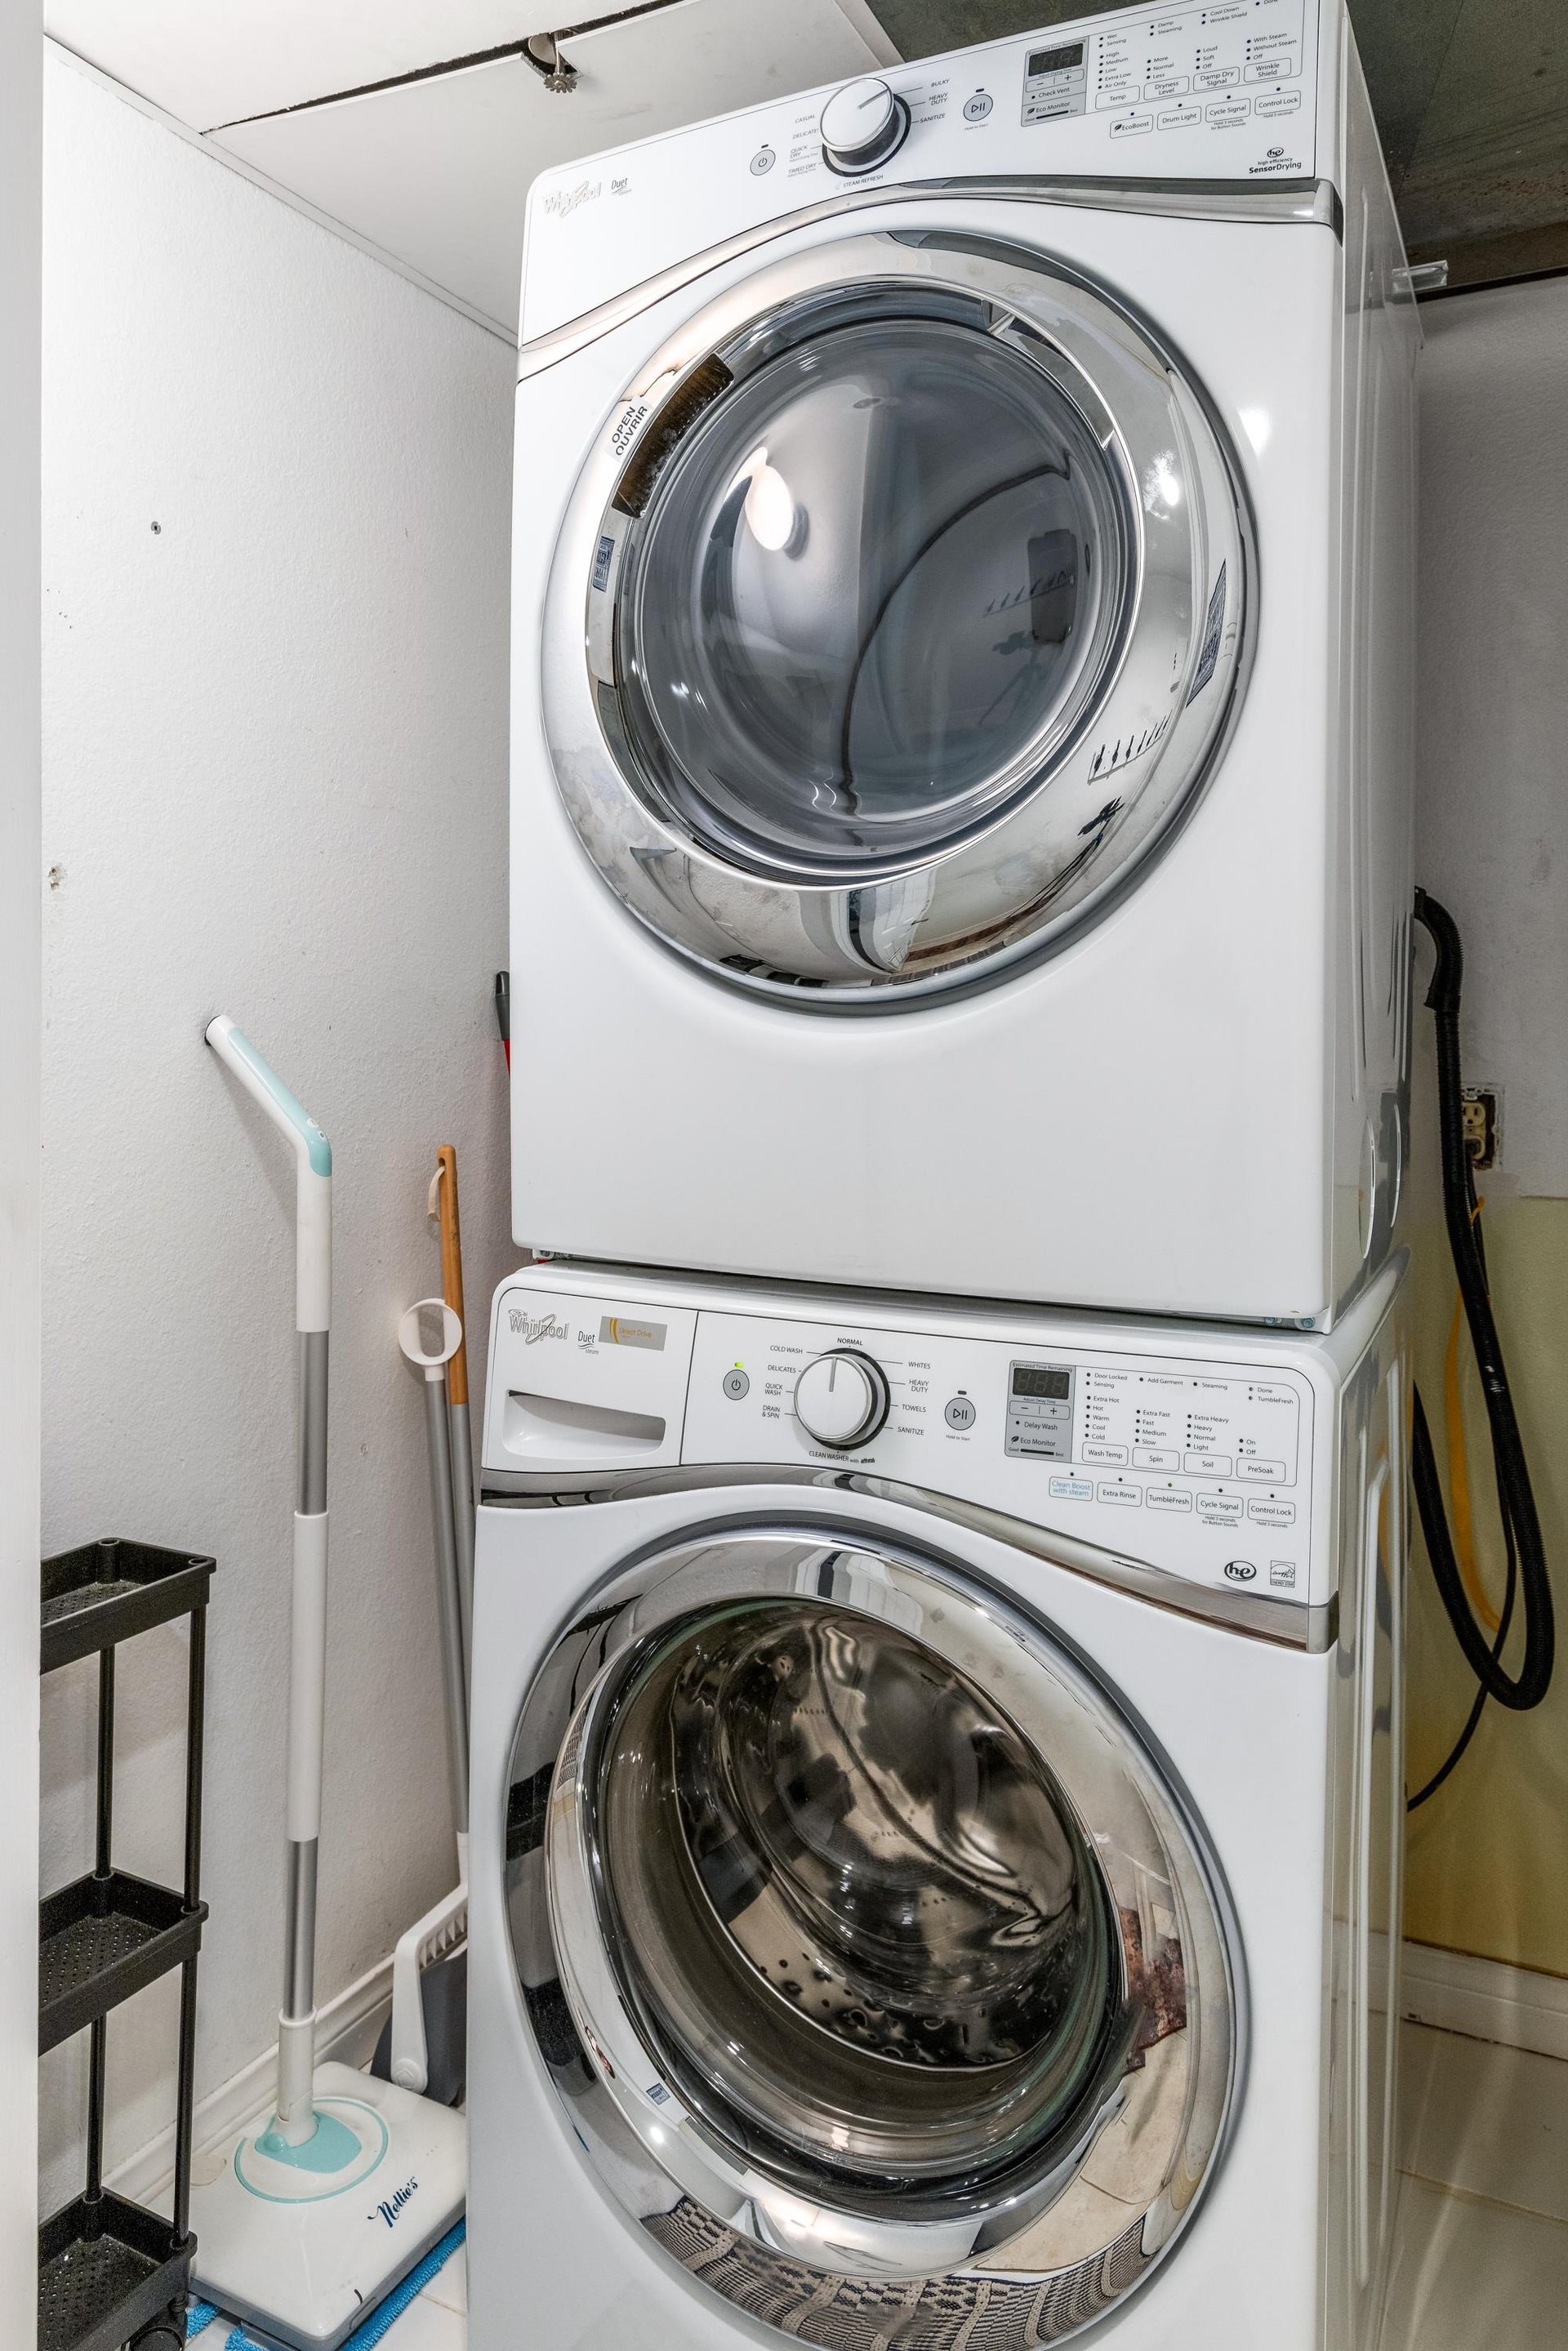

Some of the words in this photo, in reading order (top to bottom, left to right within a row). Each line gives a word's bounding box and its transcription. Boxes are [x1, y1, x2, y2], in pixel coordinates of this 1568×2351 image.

[1158, 20, 1174, 29] Damp
[1157, 25, 1183, 35] Steaming
[1268, 32, 1287, 41] Steam
[1253, 43, 1275, 51] Without
[1276, 39, 1297, 48] Steam
[1106, 57, 1129, 65] Medium
[1153, 63, 1174, 71] Normal
[1255, 62, 1280, 71] Wrinkle
[1200, 73, 1220, 82] Damp
[1222, 71, 1235, 80] Dry
[1258, 69, 1277, 78] Shield
[931, 78, 950, 87] BULKY
[1113, 80, 1127, 88] Only
[1155, 81, 1179, 91] Dryness
[1207, 78, 1227, 87] Signal
[1038, 89, 1055, 99] Check
[1057, 87, 1070, 95] Vent
[1159, 87, 1174, 96] Level
[929, 92, 948, 101] HEAVY
[931, 97, 947, 105] DUTY
[1110, 94, 1126, 102] Temp
[1047, 101, 1071, 111] Monitor
[1258, 100, 1281, 109] Control
[1283, 96, 1298, 105] Lock
[1209, 108, 1226, 117] Cycle
[1227, 105, 1246, 114] Signal
[920, 114, 946, 123] SANITIZE
[1162, 116, 1179, 124] Drum
[1180, 113, 1197, 122] Light
[1122, 121, 1149, 131] EcoBoost
[1249, 162, 1302, 174] SensorDrying
[611, 177, 627, 189] Duet
[843, 180, 861, 189] STEAM
[862, 174, 883, 184] REFRESH
[612, 406, 636, 444] OPEN
[615, 406, 648, 456] OUVRIR
[510, 1313, 569, 1344] Whirlpool
[620, 1327, 636, 1336] Direct
[637, 1329, 653, 1338] Drive
[577, 1330, 595, 1344] Duet
[837, 1338, 863, 1346] NORMAL
[768, 1365, 796, 1374] DELICATES
[908, 1361, 931, 1369] WHITES
[765, 1383, 783, 1391] QUICK
[1202, 1382, 1227, 1390] Steaming
[1258, 1396, 1294, 1405] TumbleFresh
[763, 1405, 780, 1413] DRAIN
[902, 1404, 927, 1413] TOWELS
[1210, 1416, 1229, 1424] Heavy
[1024, 1422, 1041, 1430] Delay
[1194, 1424, 1213, 1432] Heavy
[898, 1427, 924, 1436] SANITIZE
[1194, 1434, 1216, 1442] Normal
[1032, 1439, 1056, 1447] Monitor
[808, 1450, 826, 1459] CLEAN
[826, 1453, 849, 1462] WASHER
[1106, 1451, 1122, 1459] Temp
[1149, 1455, 1164, 1463] Spin
[1202, 1460, 1214, 1468] Soil
[1247, 1465, 1274, 1475] PreSoak
[1052, 1481, 1071, 1489] Clean
[1071, 1482, 1090, 1491] Boost
[1102, 1489, 1118, 1497] Extra
[1119, 1490, 1136, 1499] Rinse
[1149, 1494, 1190, 1505] TumbleFresh
[1200, 1500, 1218, 1508] Cycle
[1218, 1502, 1239, 1511] Signal
[1250, 1506, 1275, 1514] Control
[1276, 1508, 1292, 1516] Lock
[1227, 1561, 1254, 1580] he
[367, 2176, 418, 2228] Nellie's
